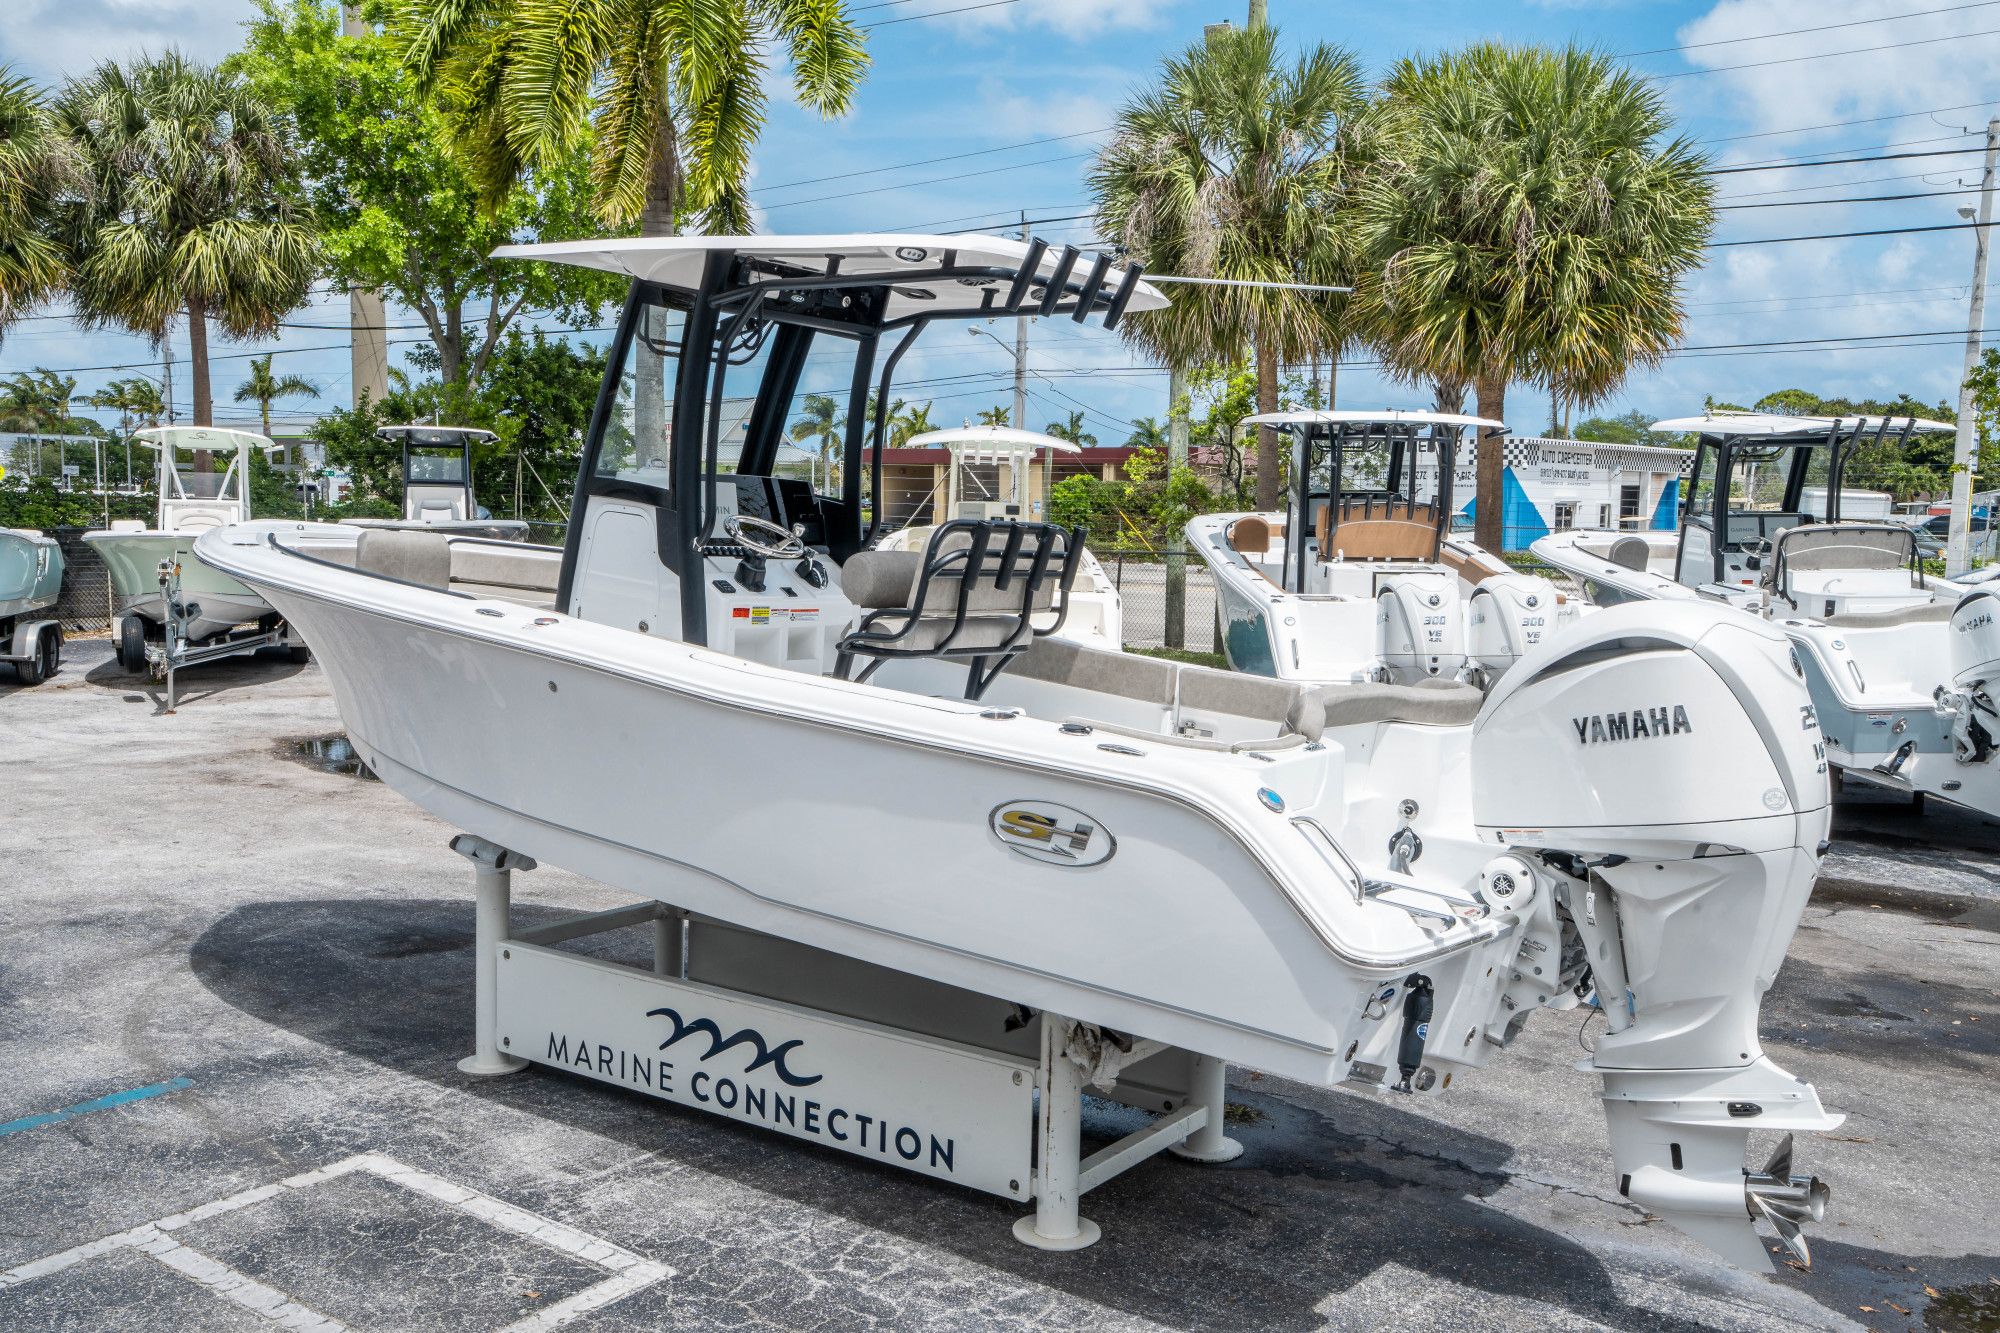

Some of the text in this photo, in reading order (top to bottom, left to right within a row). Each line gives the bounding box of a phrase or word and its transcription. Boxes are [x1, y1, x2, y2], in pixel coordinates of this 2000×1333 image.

[1541, 450, 1555, 463] AUTO
[1423, 616, 1446, 625] 300
[1522, 617, 1544, 627] 300
[1573, 704, 1693, 745] YAMAHA
[548, 1031, 956, 1173] MARINE CONNECTION
